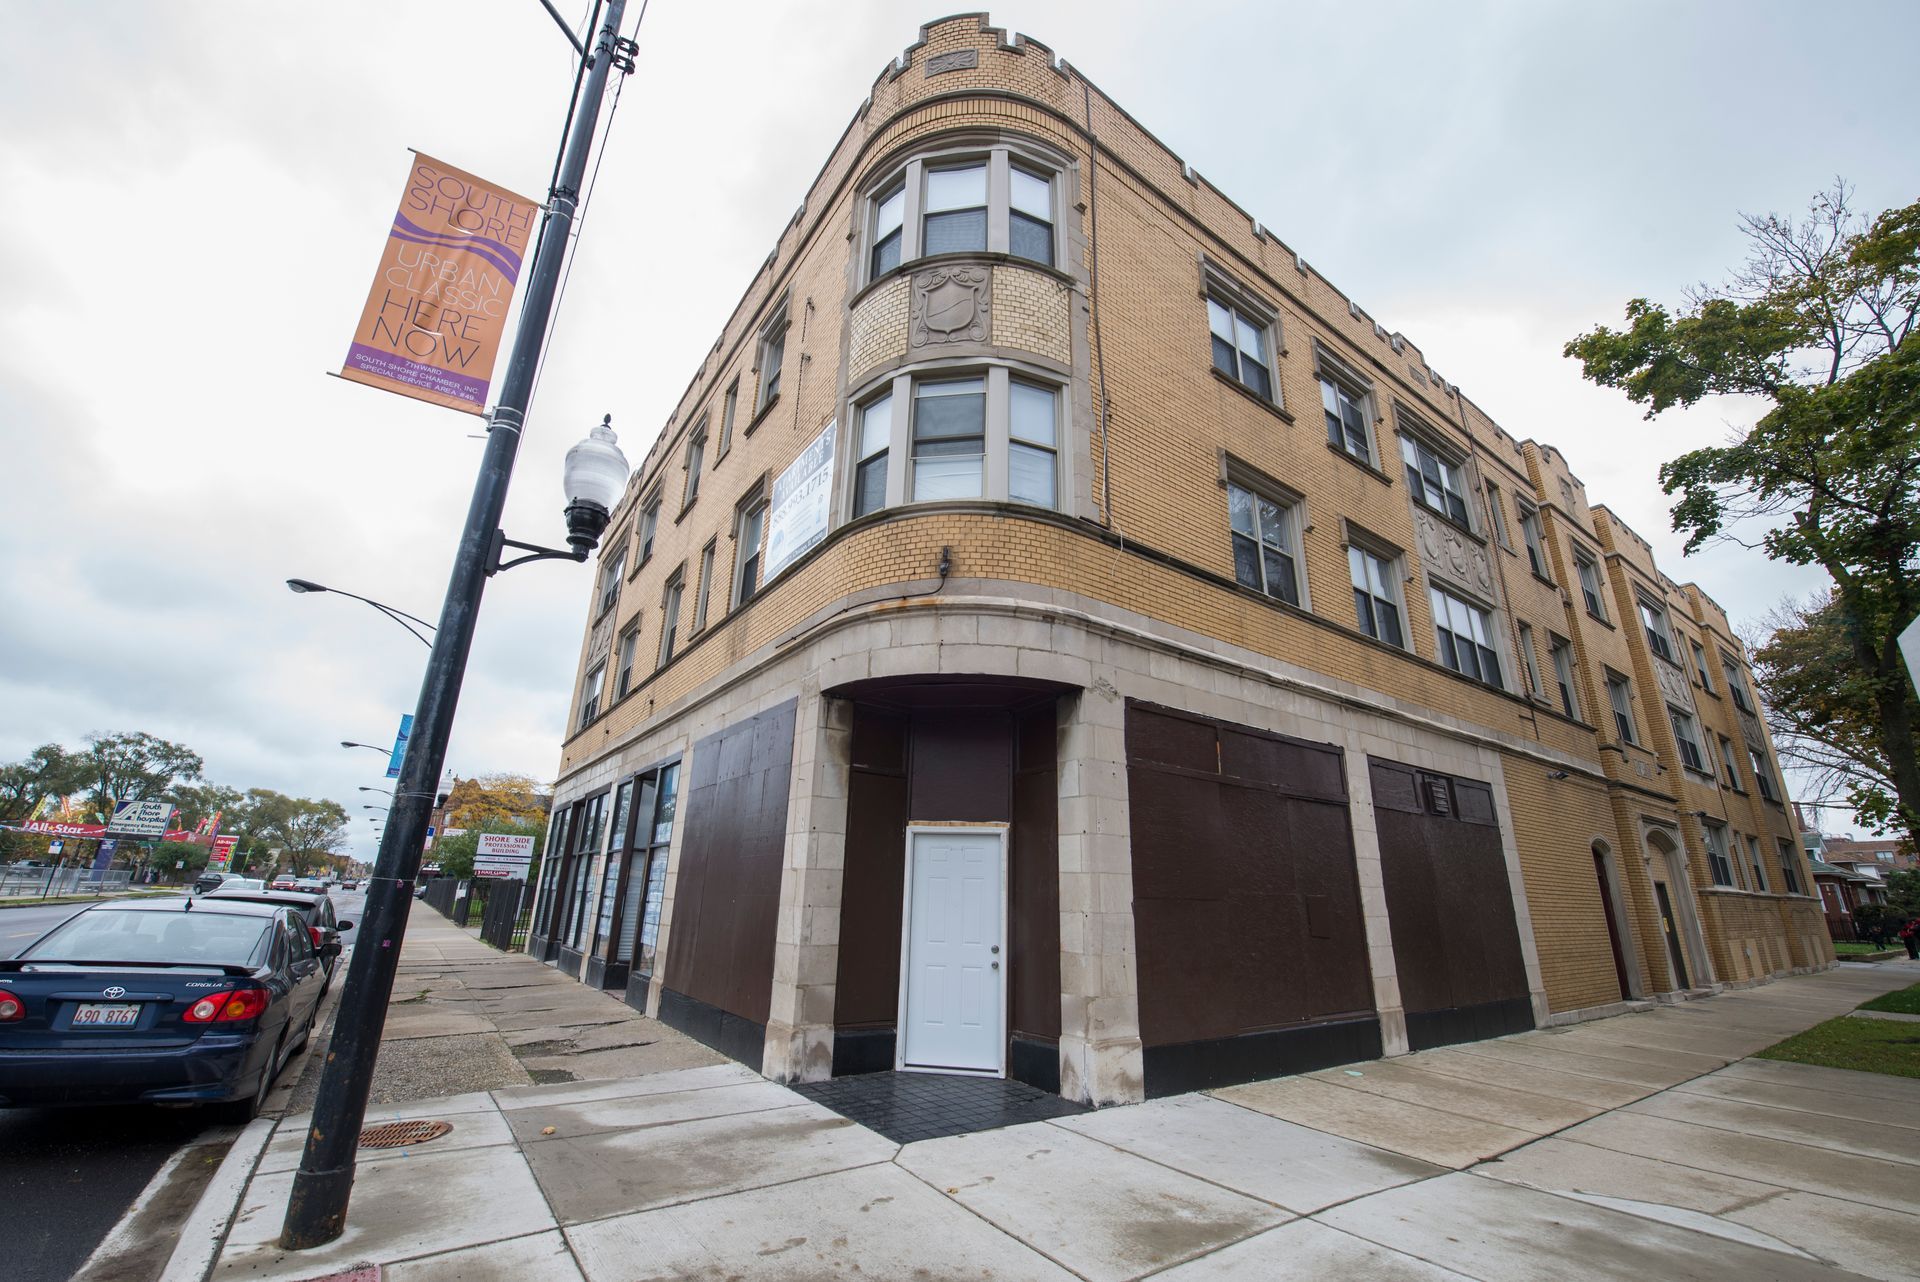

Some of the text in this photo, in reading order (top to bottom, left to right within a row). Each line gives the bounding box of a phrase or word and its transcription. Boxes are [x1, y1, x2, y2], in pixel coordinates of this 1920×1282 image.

[408, 187, 526, 249] SHORE
[414, 166, 531, 228] SOUTH
[386, 267, 504, 317] CLASSIC
[397, 244, 502, 296] URBAN
[381, 289, 487, 343] HERE
[355, 353, 387, 367] SOUTH
[388, 363, 418, 376] SHORE
[372, 316, 480, 368] NOW
[360, 363, 395, 378] SPECIAL
[397, 374, 433, 389] SERVICE
[434, 385, 457, 396] AREA
[418, 364, 442, 375] WARD
[53, 824, 84, 834] Star
[75, 1010, 138, 1023] 490 8767
